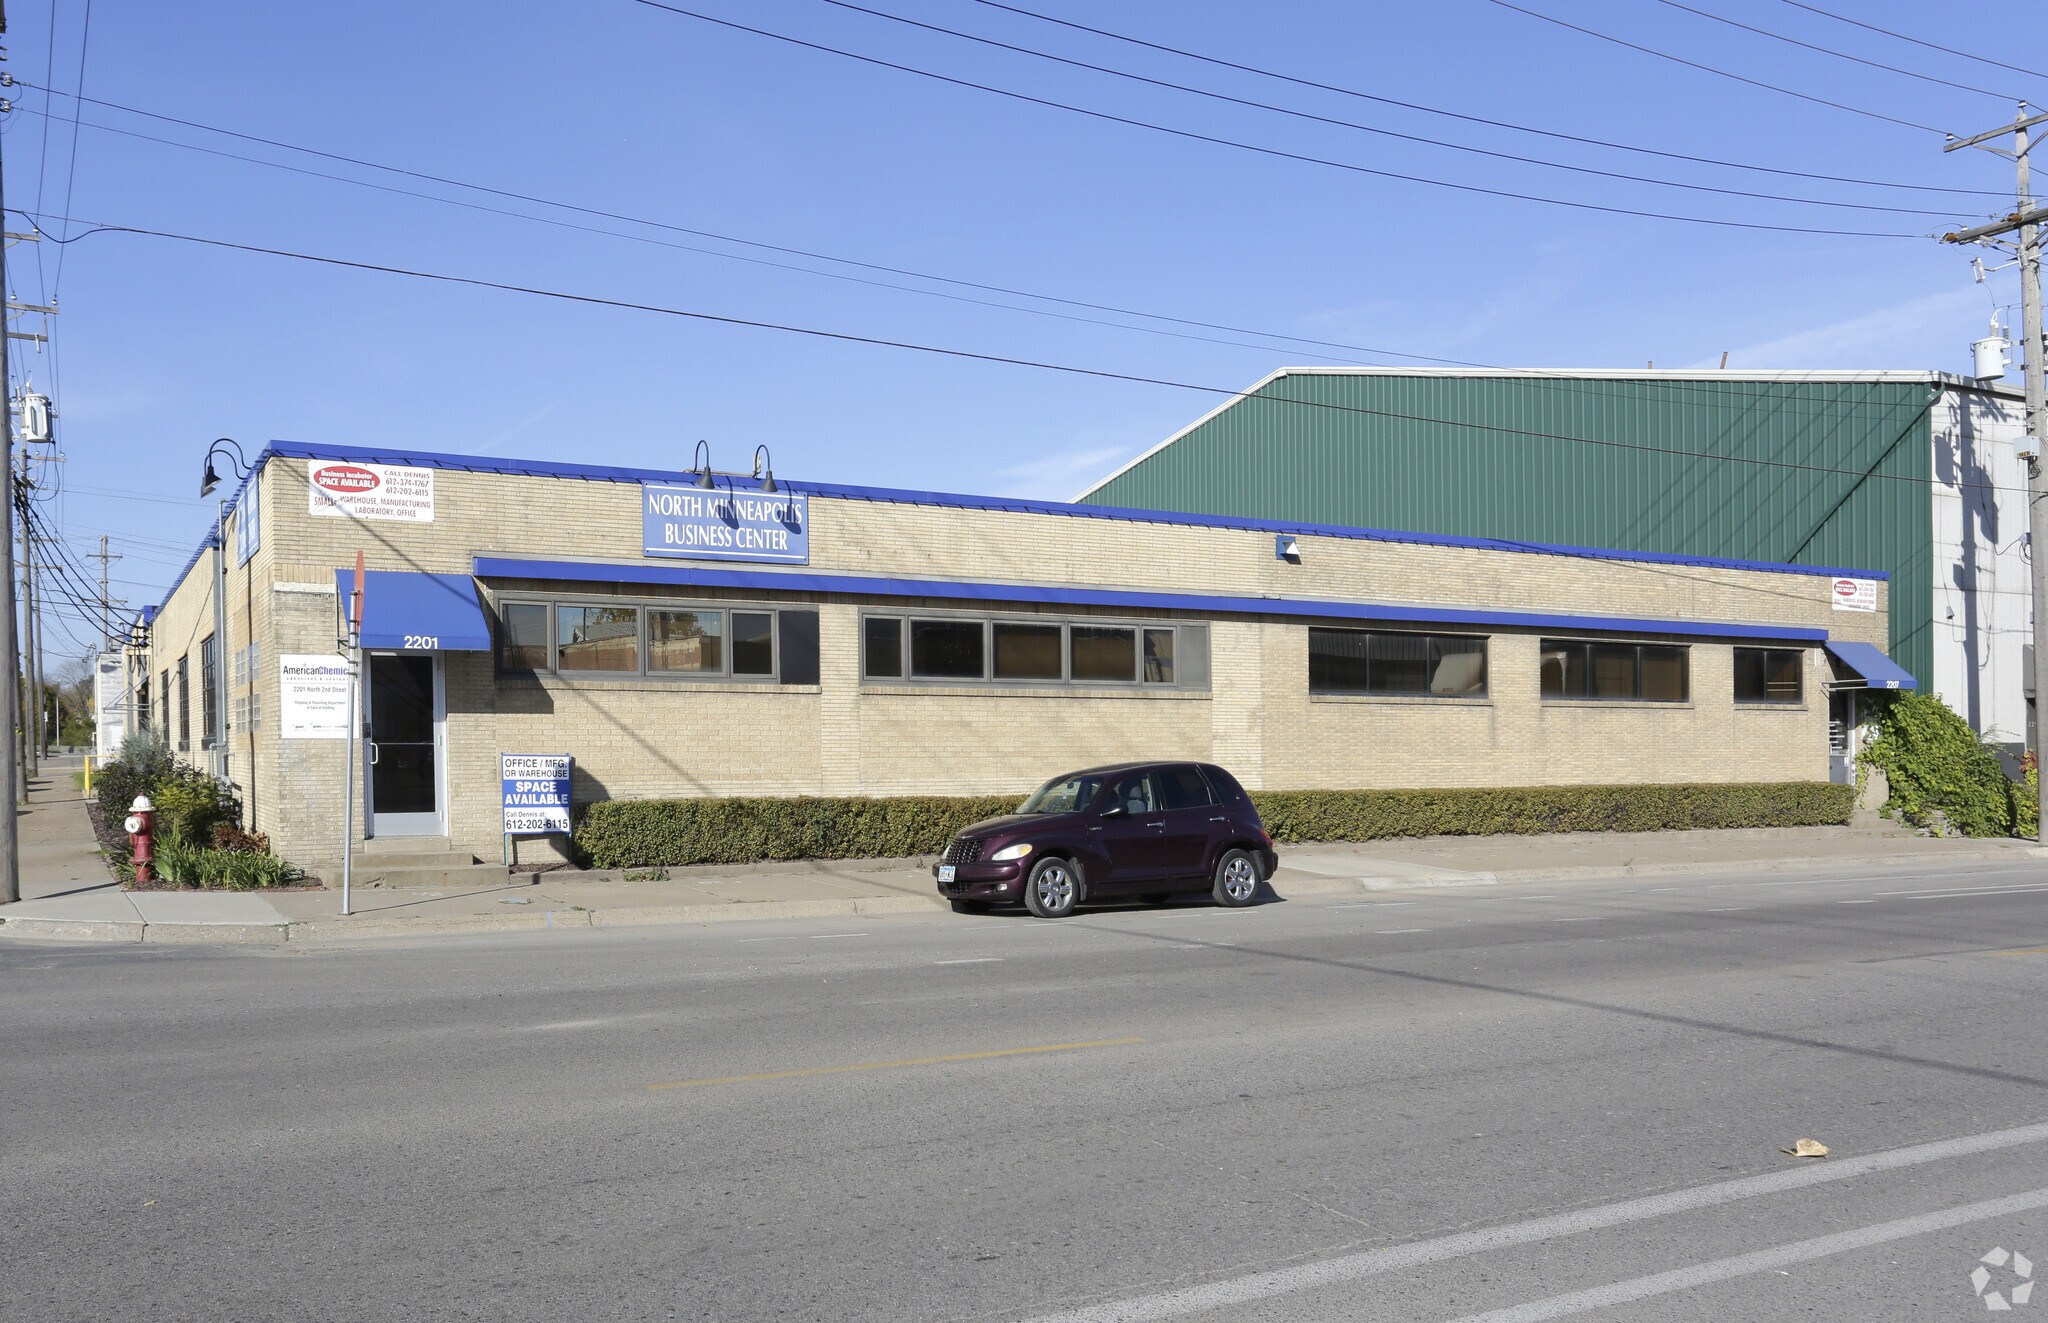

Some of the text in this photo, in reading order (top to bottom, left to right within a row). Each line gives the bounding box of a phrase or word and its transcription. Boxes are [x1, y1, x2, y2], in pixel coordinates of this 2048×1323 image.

[320, 470, 372, 479] Business Incubator
[318, 478, 376, 488] SPACE AVAILABLE
[385, 478, 429, 488] 612-374-1767
[386, 487, 429, 496] 612-202-6115
[340, 496, 431, 508] WAREHOUSE, MANUFACTURING
[355, 506, 416, 518] LABORATORY, OFFICE
[649, 494, 802, 524] NORTH MINNEAPOLIS
[665, 523, 788, 550] BUSINESS CENTER
[404, 636, 438, 649] 2201
[283, 665, 349, 675] AmericanChemic
[505, 758, 567, 768] OFFICE / MFG.
[515, 781, 557, 792] SPACE
[505, 793, 568, 805] AVAILABLE
[506, 819, 568, 829] 612-202-6115
